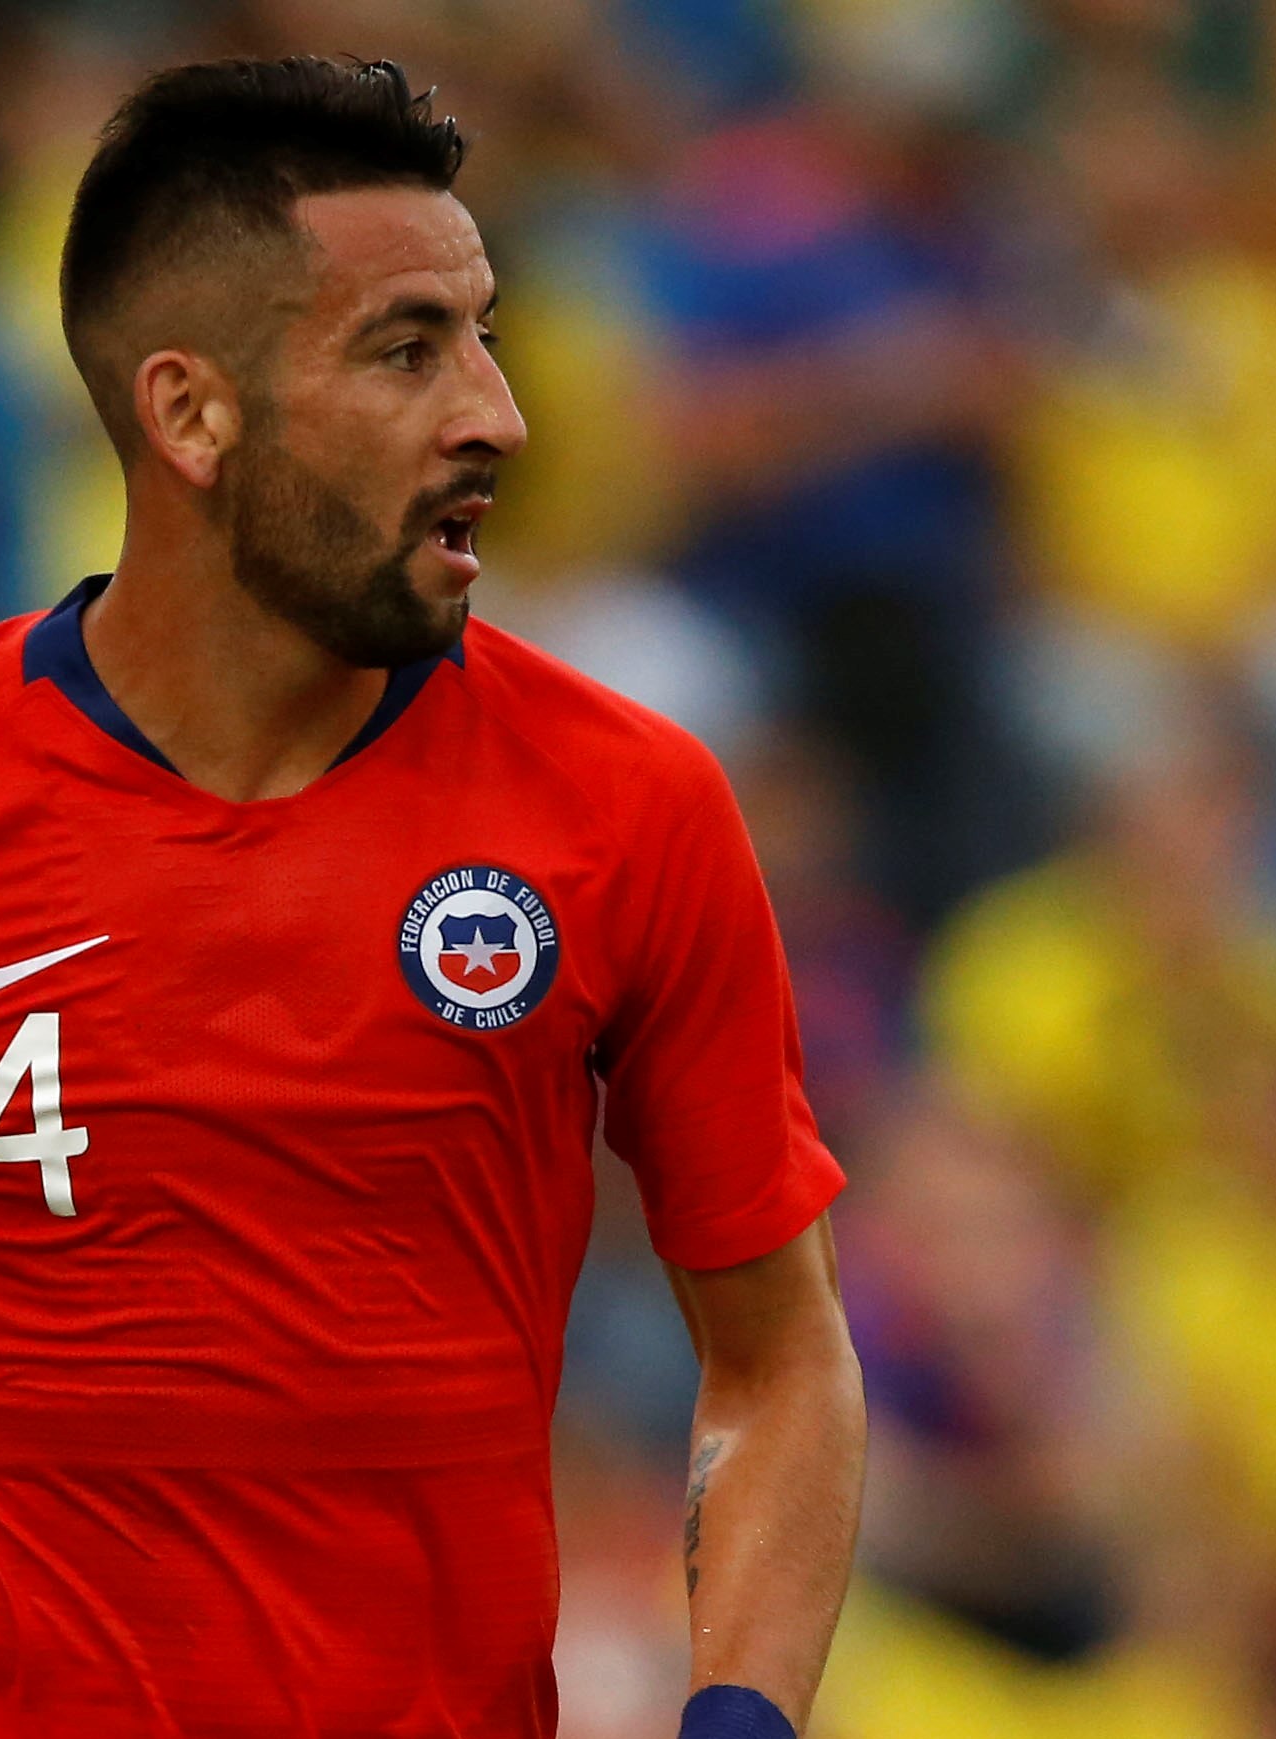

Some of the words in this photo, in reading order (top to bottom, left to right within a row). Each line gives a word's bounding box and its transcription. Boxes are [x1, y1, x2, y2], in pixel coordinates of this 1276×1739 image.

[401, 870, 473, 952] FEDERACION
[487, 871, 510, 892] DE
[514, 886, 555, 951] FUTBOL
[442, 1002, 465, 1024] DE
[475, 1001, 522, 1028] CHILE
